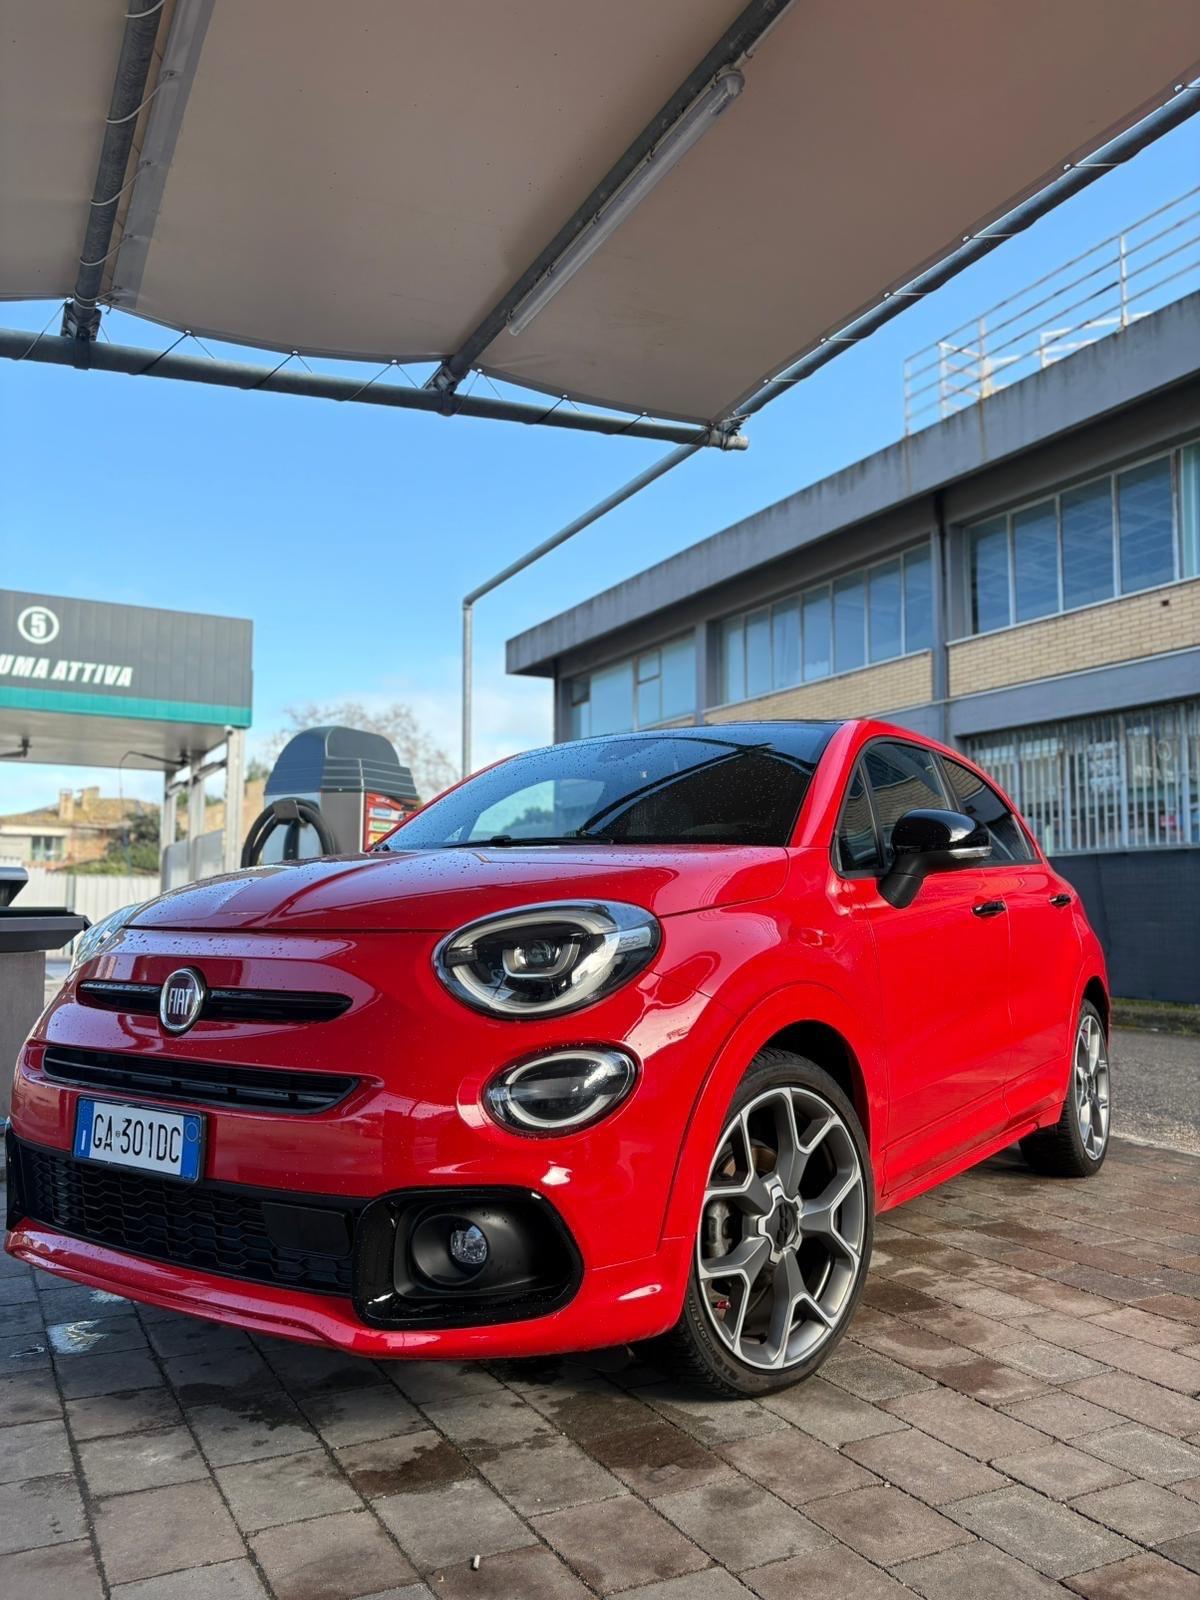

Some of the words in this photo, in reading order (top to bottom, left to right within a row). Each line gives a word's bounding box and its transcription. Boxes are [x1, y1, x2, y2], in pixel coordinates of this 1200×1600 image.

[30, 612, 47, 638] 5
[0, 654, 50, 678] UMA
[50, 660, 133, 687] ATTIVA
[167, 987, 193, 1015] FIAT
